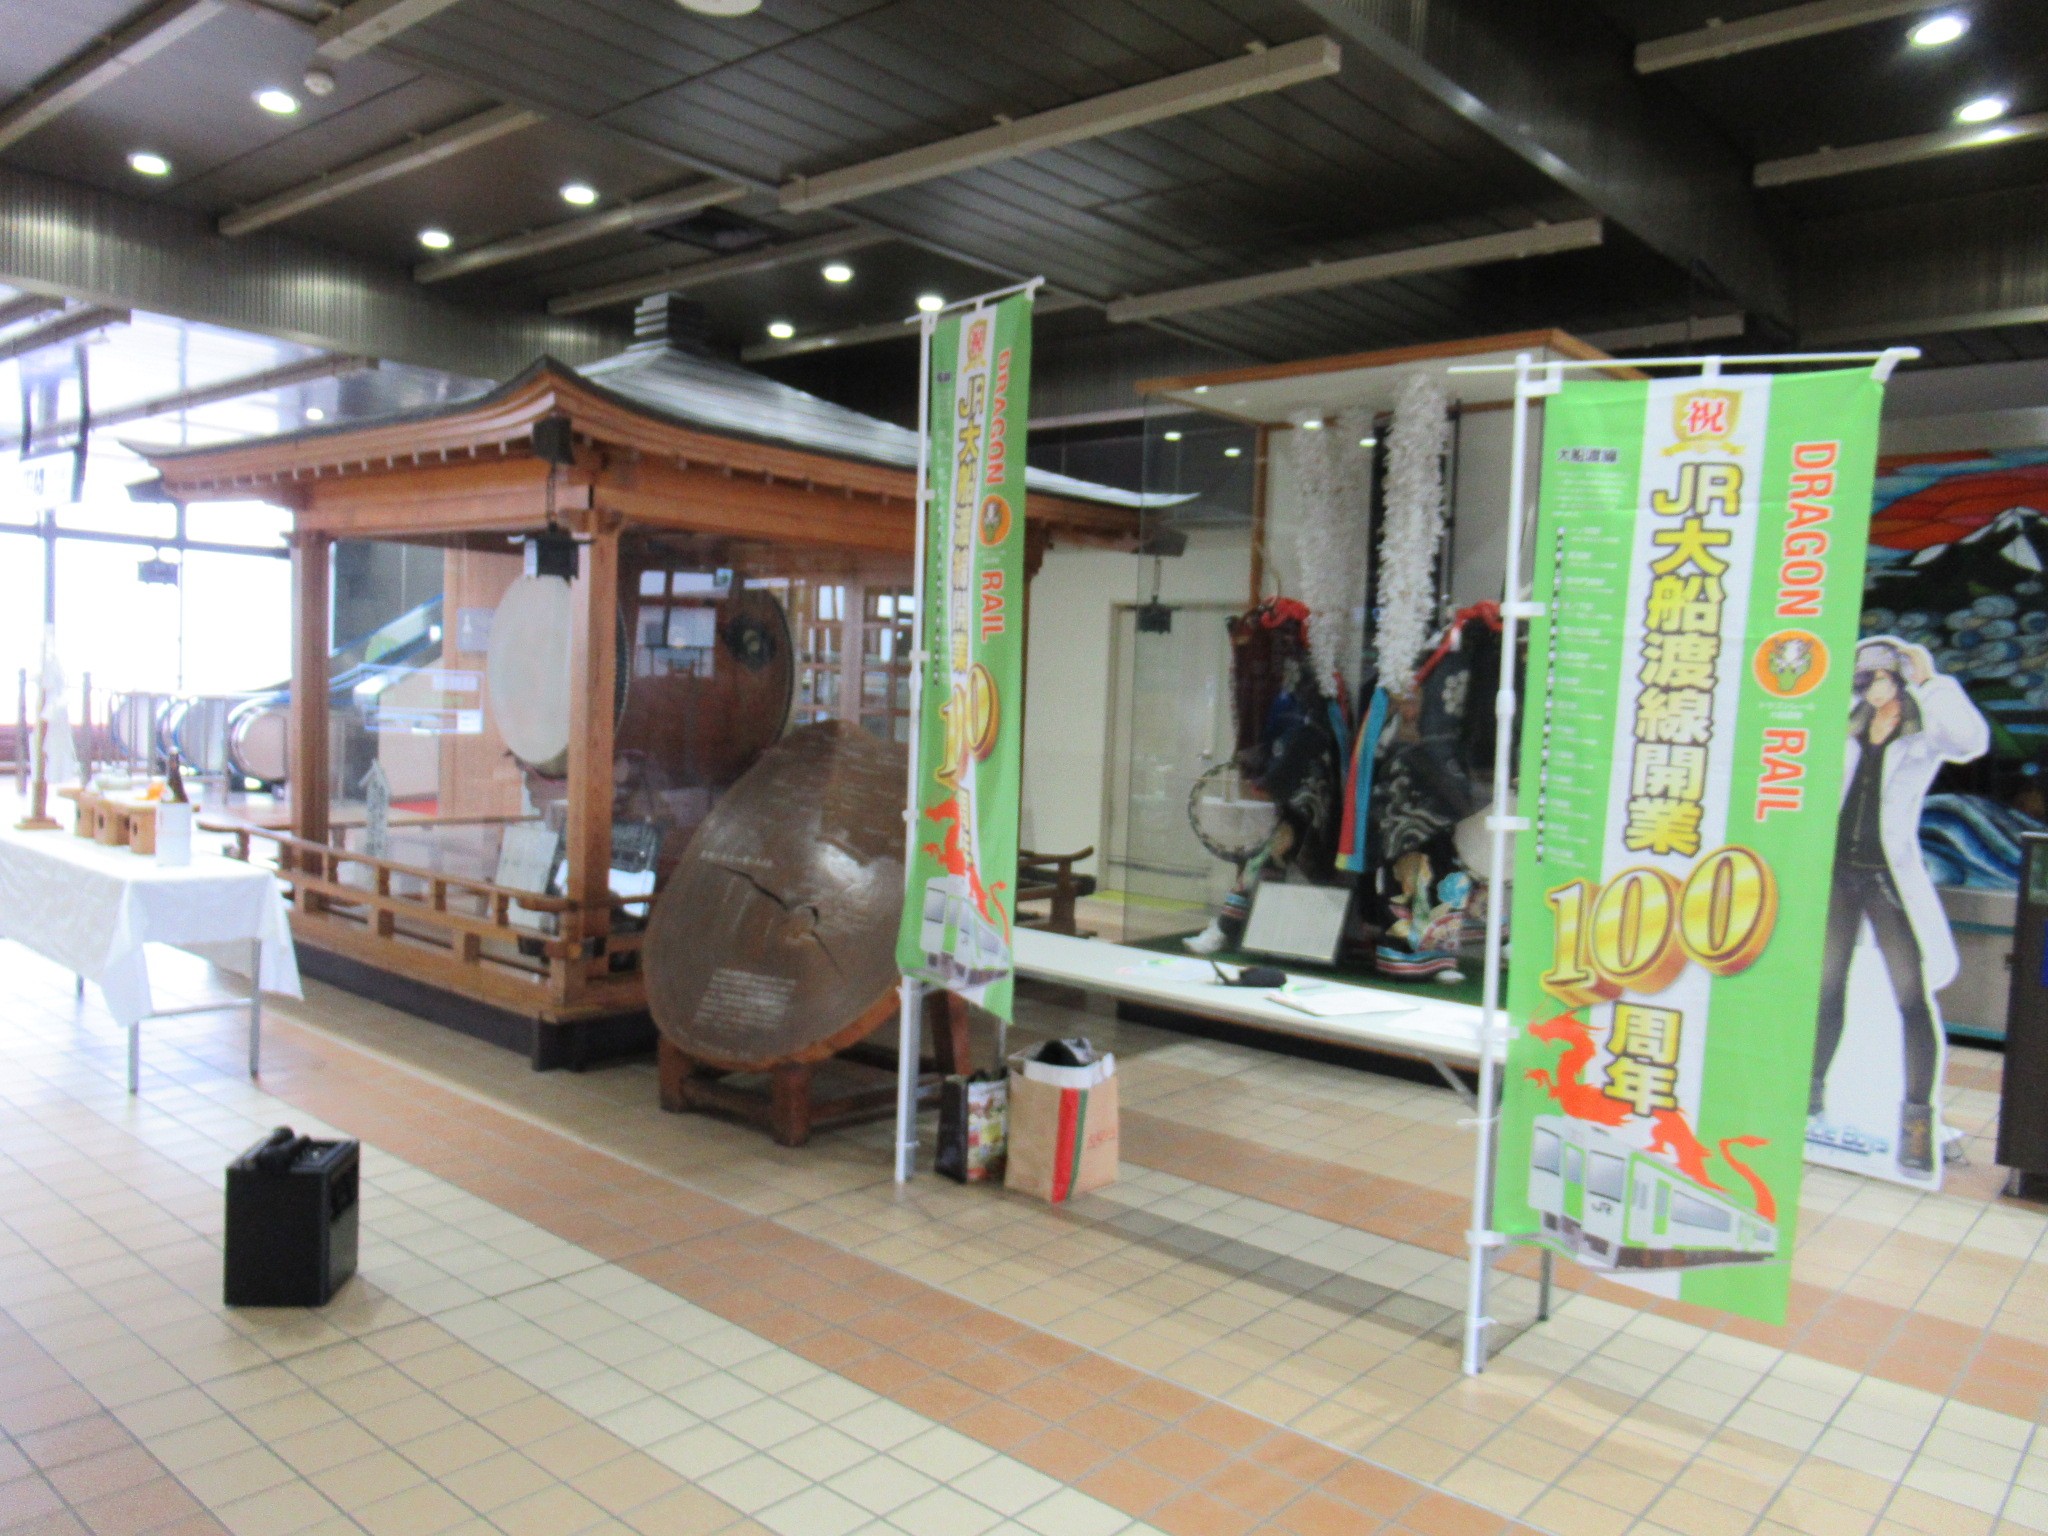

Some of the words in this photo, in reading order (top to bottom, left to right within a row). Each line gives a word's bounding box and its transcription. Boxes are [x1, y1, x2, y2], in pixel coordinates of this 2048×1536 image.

[1685, 398, 1730, 436] 祝
[1777, 440, 1840, 618] DRAGON
[980, 569, 1006, 644] RAIL
[1754, 726, 1811, 824] RAIL
[1541, 844, 1778, 1007] 100
[1601, 1000, 1684, 1118] 周年
